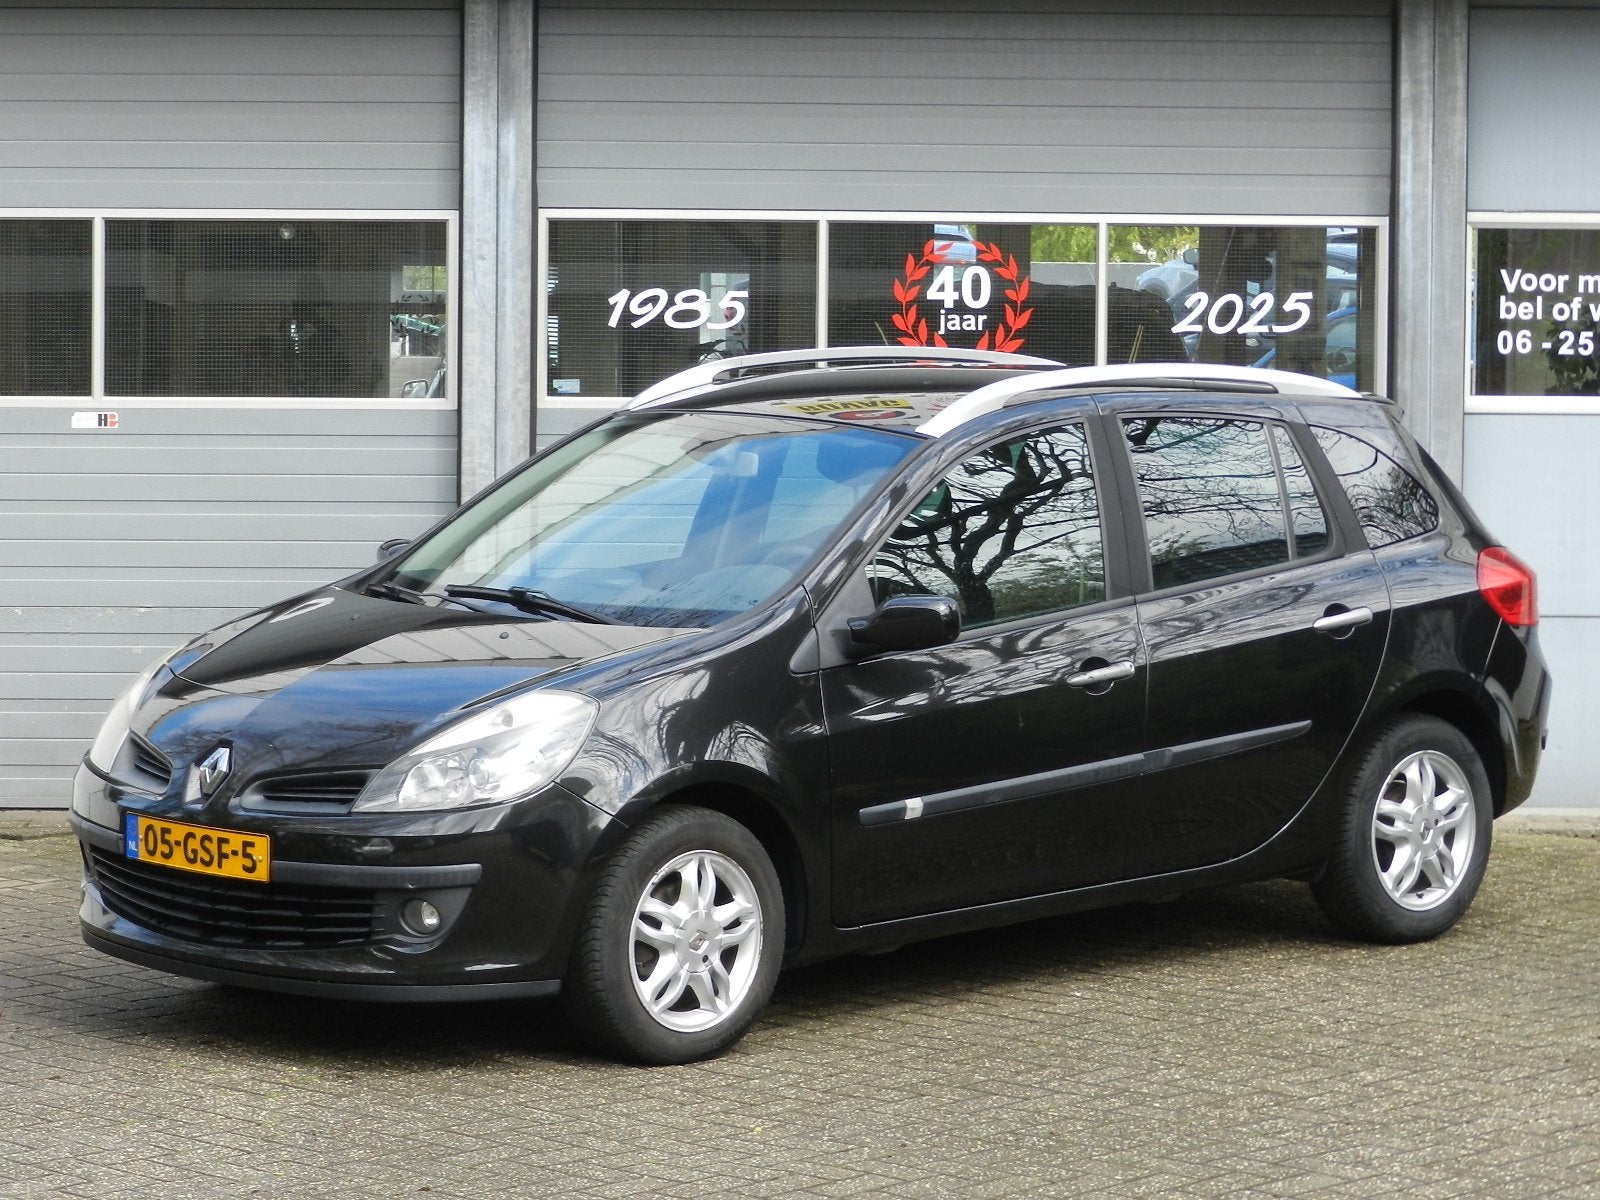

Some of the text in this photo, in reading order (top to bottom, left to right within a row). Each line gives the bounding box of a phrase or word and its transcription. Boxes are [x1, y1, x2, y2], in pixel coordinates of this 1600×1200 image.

[926, 265, 992, 309] 40
[1499, 268, 1570, 293] Voor
[607, 287, 749, 330] 1985
[937, 309, 988, 335] jaar
[1170, 291, 1314, 335] 2025
[1499, 295, 1543, 320] bel
[1552, 296, 1583, 322] of
[1496, 329, 1533, 355] 06
[1557, 329, 1595, 356] 25
[128, 823, 258, 874] NL 05-GSF-5
